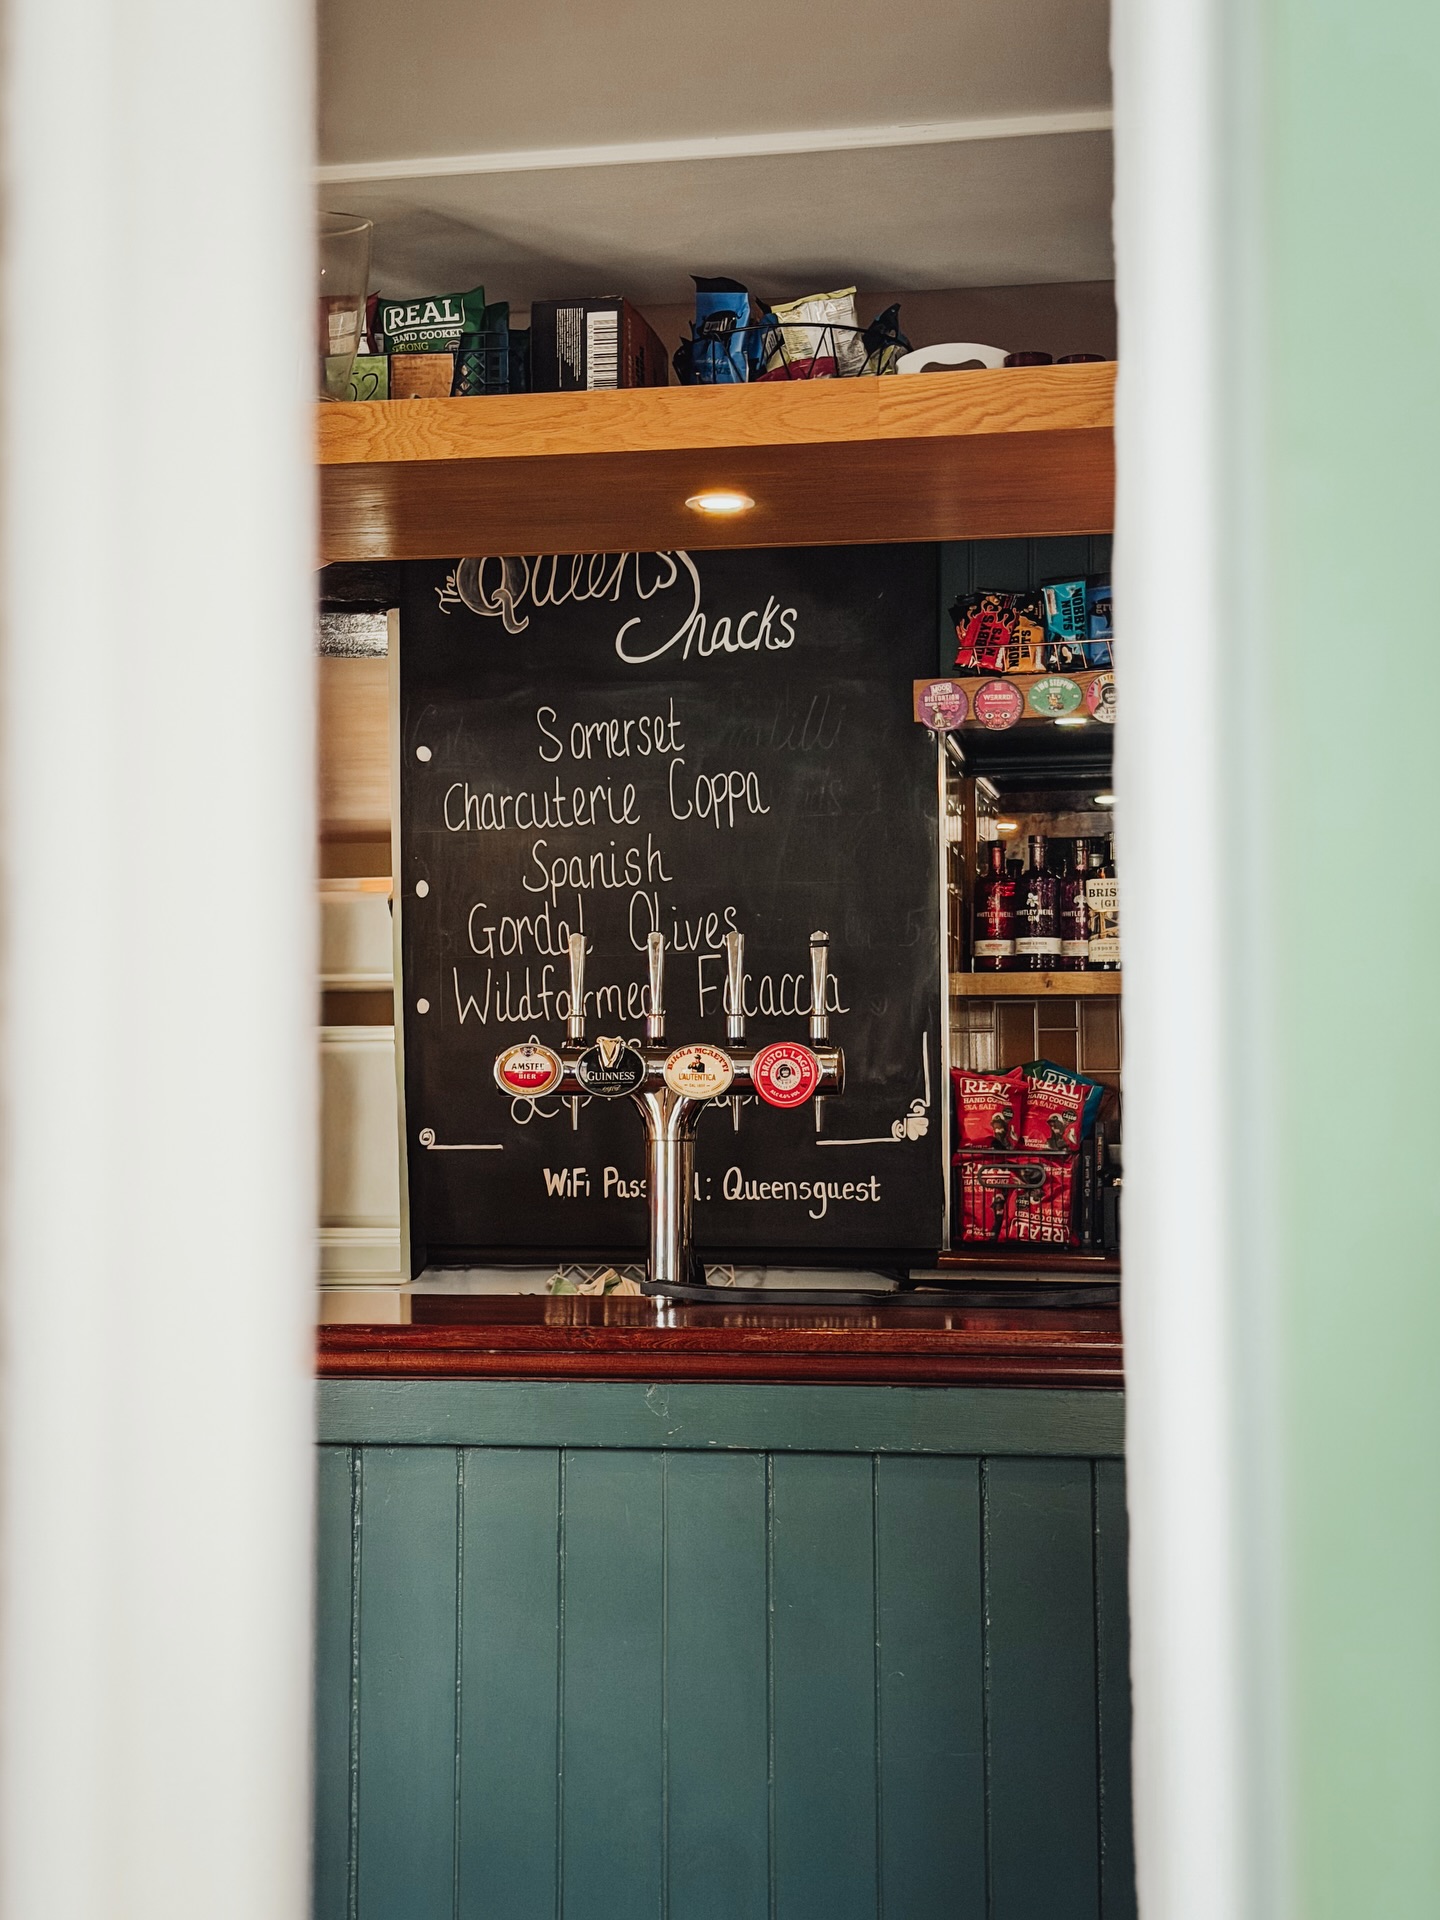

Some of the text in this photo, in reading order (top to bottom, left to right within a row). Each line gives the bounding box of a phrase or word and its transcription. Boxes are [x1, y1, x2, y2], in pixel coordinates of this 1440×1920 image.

[388, 299, 460, 330] REAL
[434, 569, 463, 615] The
[615, 550, 798, 664] Snacks
[1061, 600, 1074, 631] NUTS
[537, 697, 686, 762] Somerset
[444, 758, 771, 832] Charcuterie Coppa
[523, 833, 673, 908] Spanish
[1089, 888, 1119, 898] BRIS
[468, 893, 594, 959] Gordal
[698, 954, 850, 1017] Fcacca
[511, 1062, 545, 1071] AMSTEL
[667, 1047, 730, 1073] BIRRA MORETTI
[760, 1049, 788, 1077] BRISTOL
[790, 1050, 811, 1078] LAGER
[587, 1070, 636, 1081] GUINNESS
[964, 1079, 1012, 1099] REAL
[1031, 1076, 1080, 1100] REAL
[964, 1103, 978, 1111] SEA
[1028, 1093, 1079, 1110] HAND COOKED
[1039, 1101, 1058, 1111] SALT
[543, 1167, 590, 1198] WiFi
[722, 1166, 881, 1220] Queensguest
[1015, 1221, 1065, 1242] REAL
